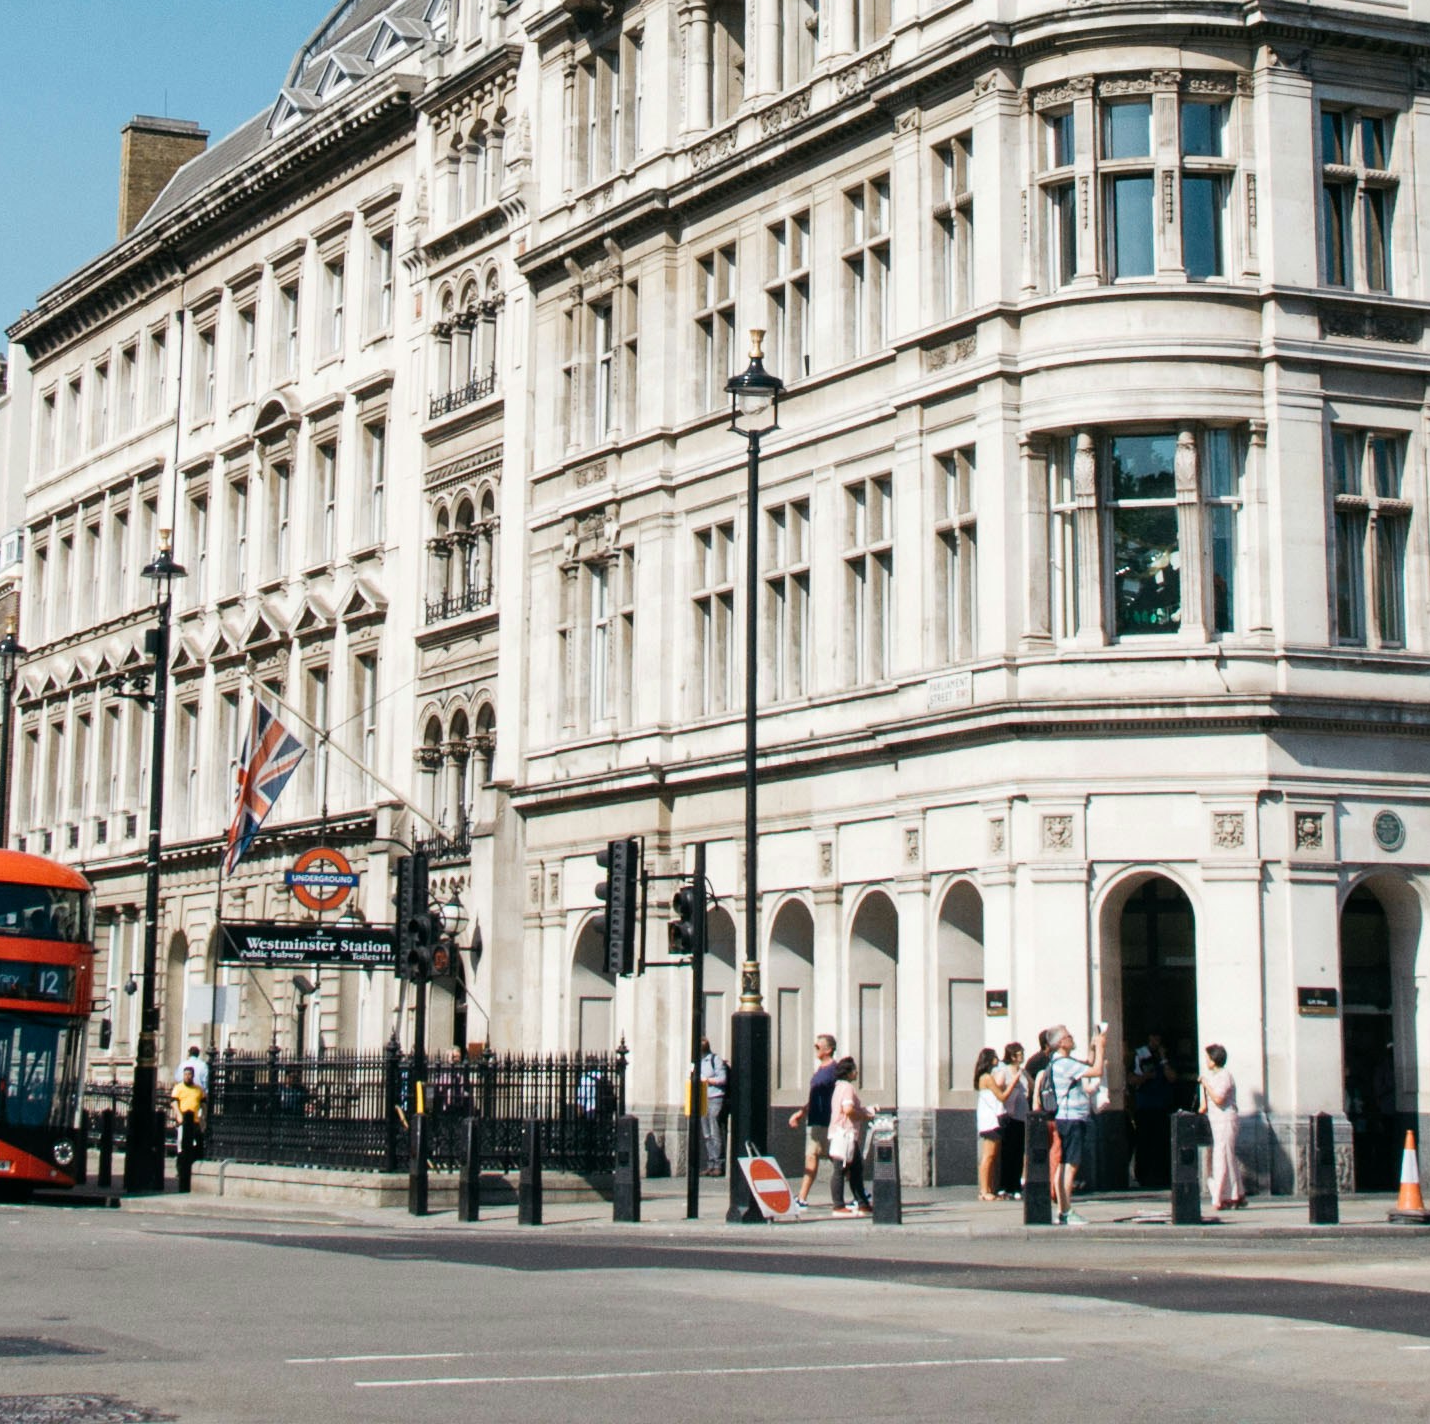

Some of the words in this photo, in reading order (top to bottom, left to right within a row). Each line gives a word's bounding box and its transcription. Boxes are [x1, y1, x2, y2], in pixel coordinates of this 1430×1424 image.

[291, 874, 353, 884] UNDERGROUND
[246, 936, 337, 952] Westminster
[340, 939, 392, 953] Station
[240, 949, 268, 959] Public
[271, 950, 306, 961] Subway
[352, 952, 380, 961] Toilets
[39, 970, 59, 994] 12
